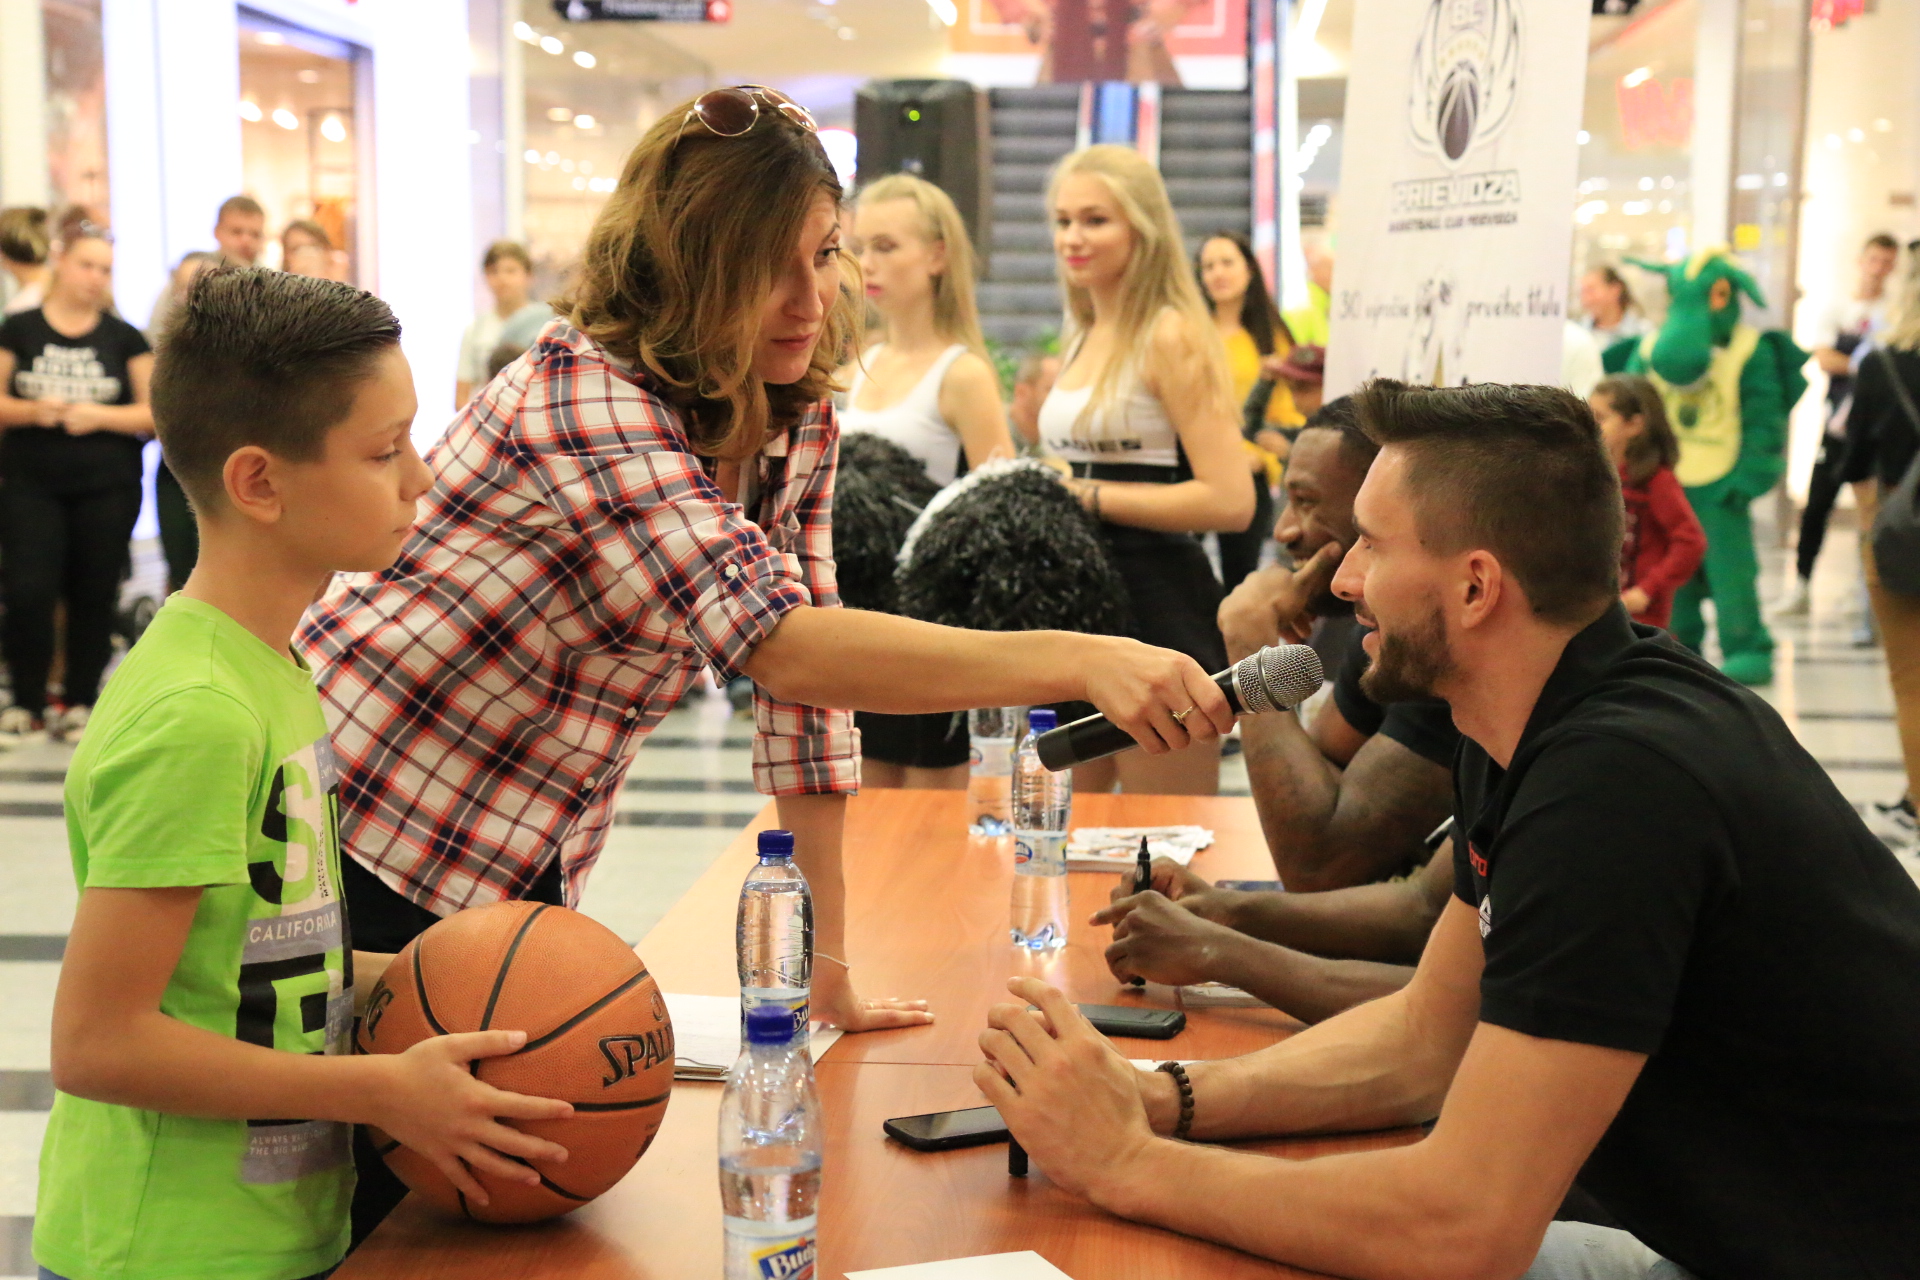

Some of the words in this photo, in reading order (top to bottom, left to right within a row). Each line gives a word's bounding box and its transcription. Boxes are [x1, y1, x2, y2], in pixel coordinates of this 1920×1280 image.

[251, 1135, 288, 1145] ALWAYS
[249, 1147, 269, 1156] THE
[273, 1146, 288, 1155] BIG
